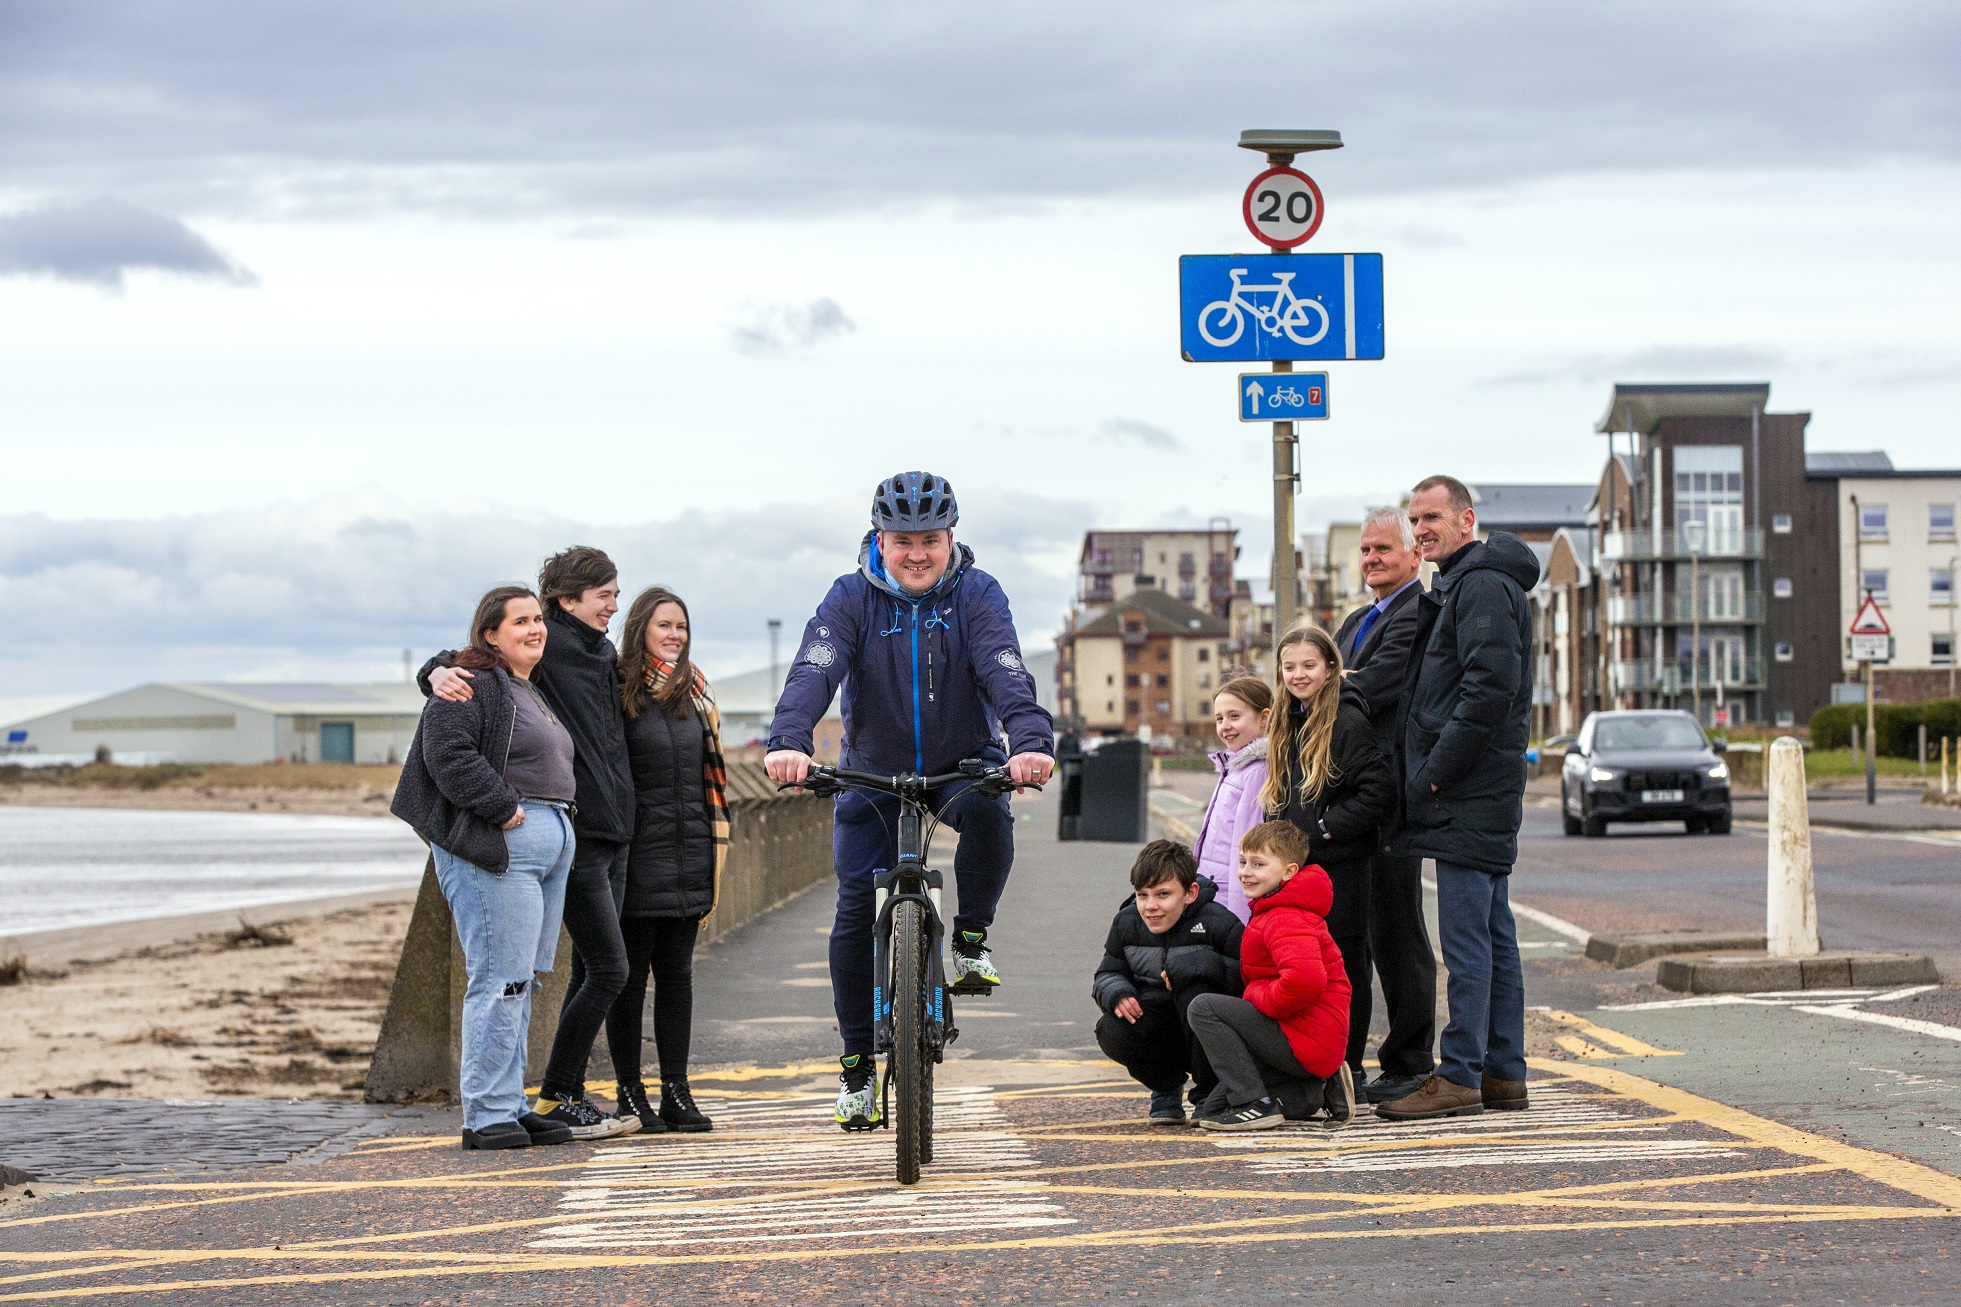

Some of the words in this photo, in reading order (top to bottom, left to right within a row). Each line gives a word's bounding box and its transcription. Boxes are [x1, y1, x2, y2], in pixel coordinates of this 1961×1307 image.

[1257, 190, 1313, 224] 20
[1311, 390, 1319, 402] 7
[934, 986, 943, 1022] ROCKSHOX
